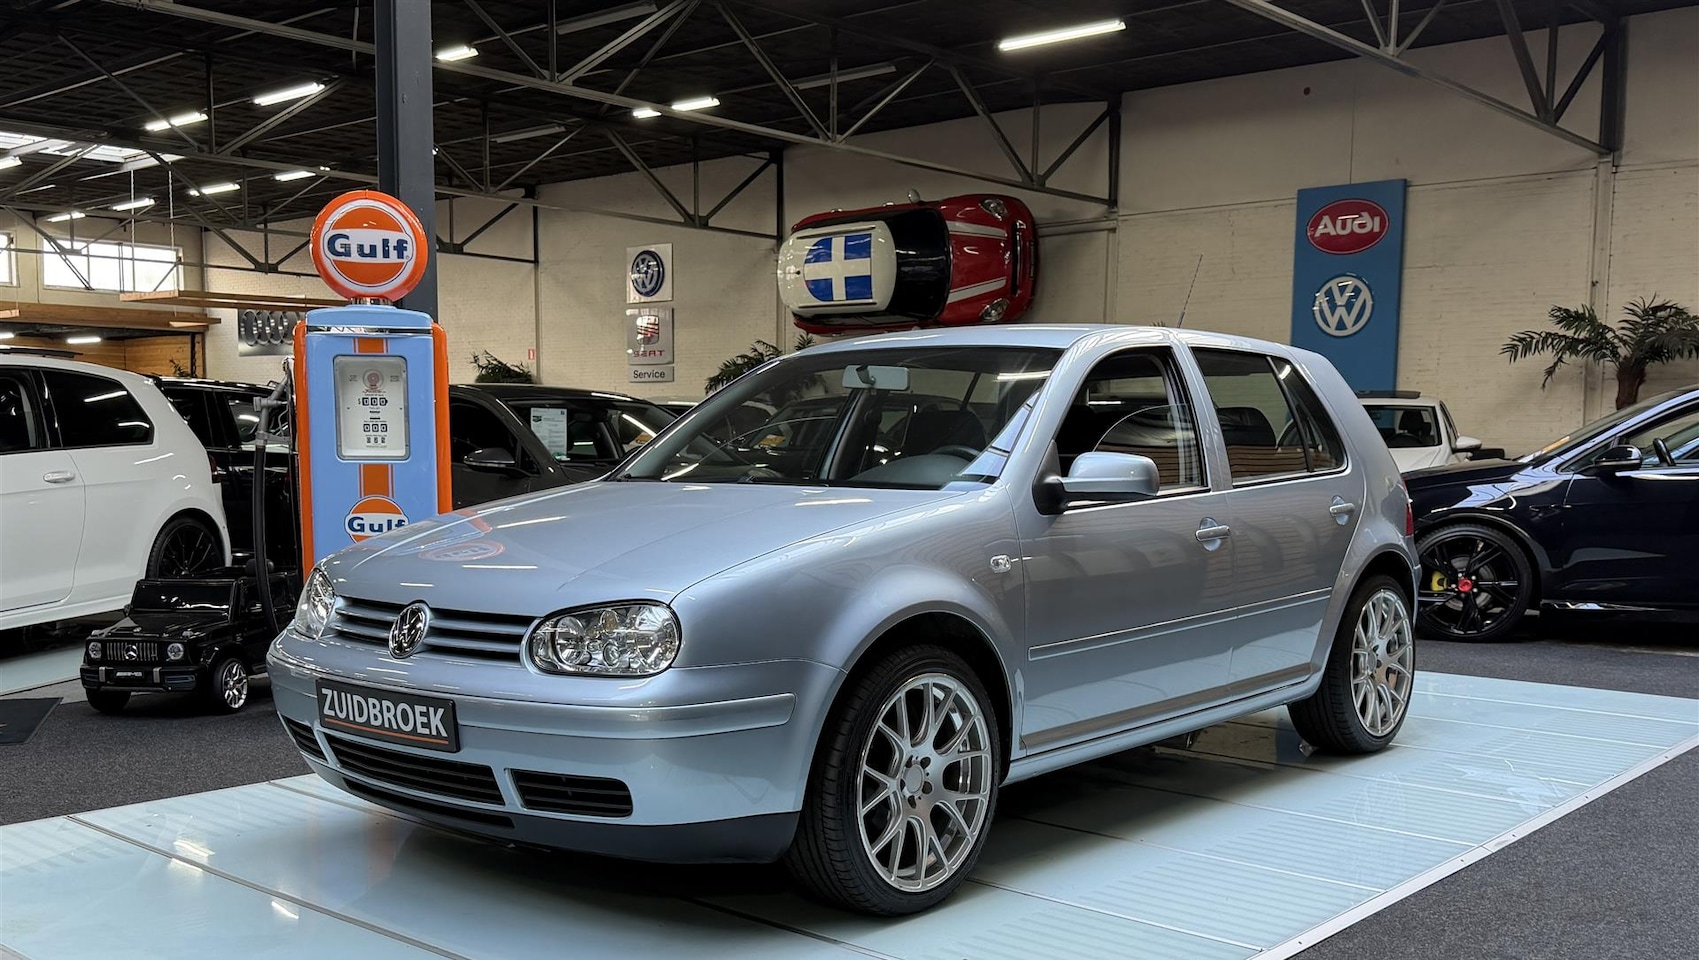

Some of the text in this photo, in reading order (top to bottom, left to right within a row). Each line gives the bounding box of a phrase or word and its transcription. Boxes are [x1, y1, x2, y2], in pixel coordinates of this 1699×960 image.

[327, 233, 408, 259] Gulf
[1314, 276, 1373, 336] VW
[633, 370, 665, 379] Service
[347, 516, 406, 533] Gulf
[321, 688, 448, 737] ZUIDBROEK
